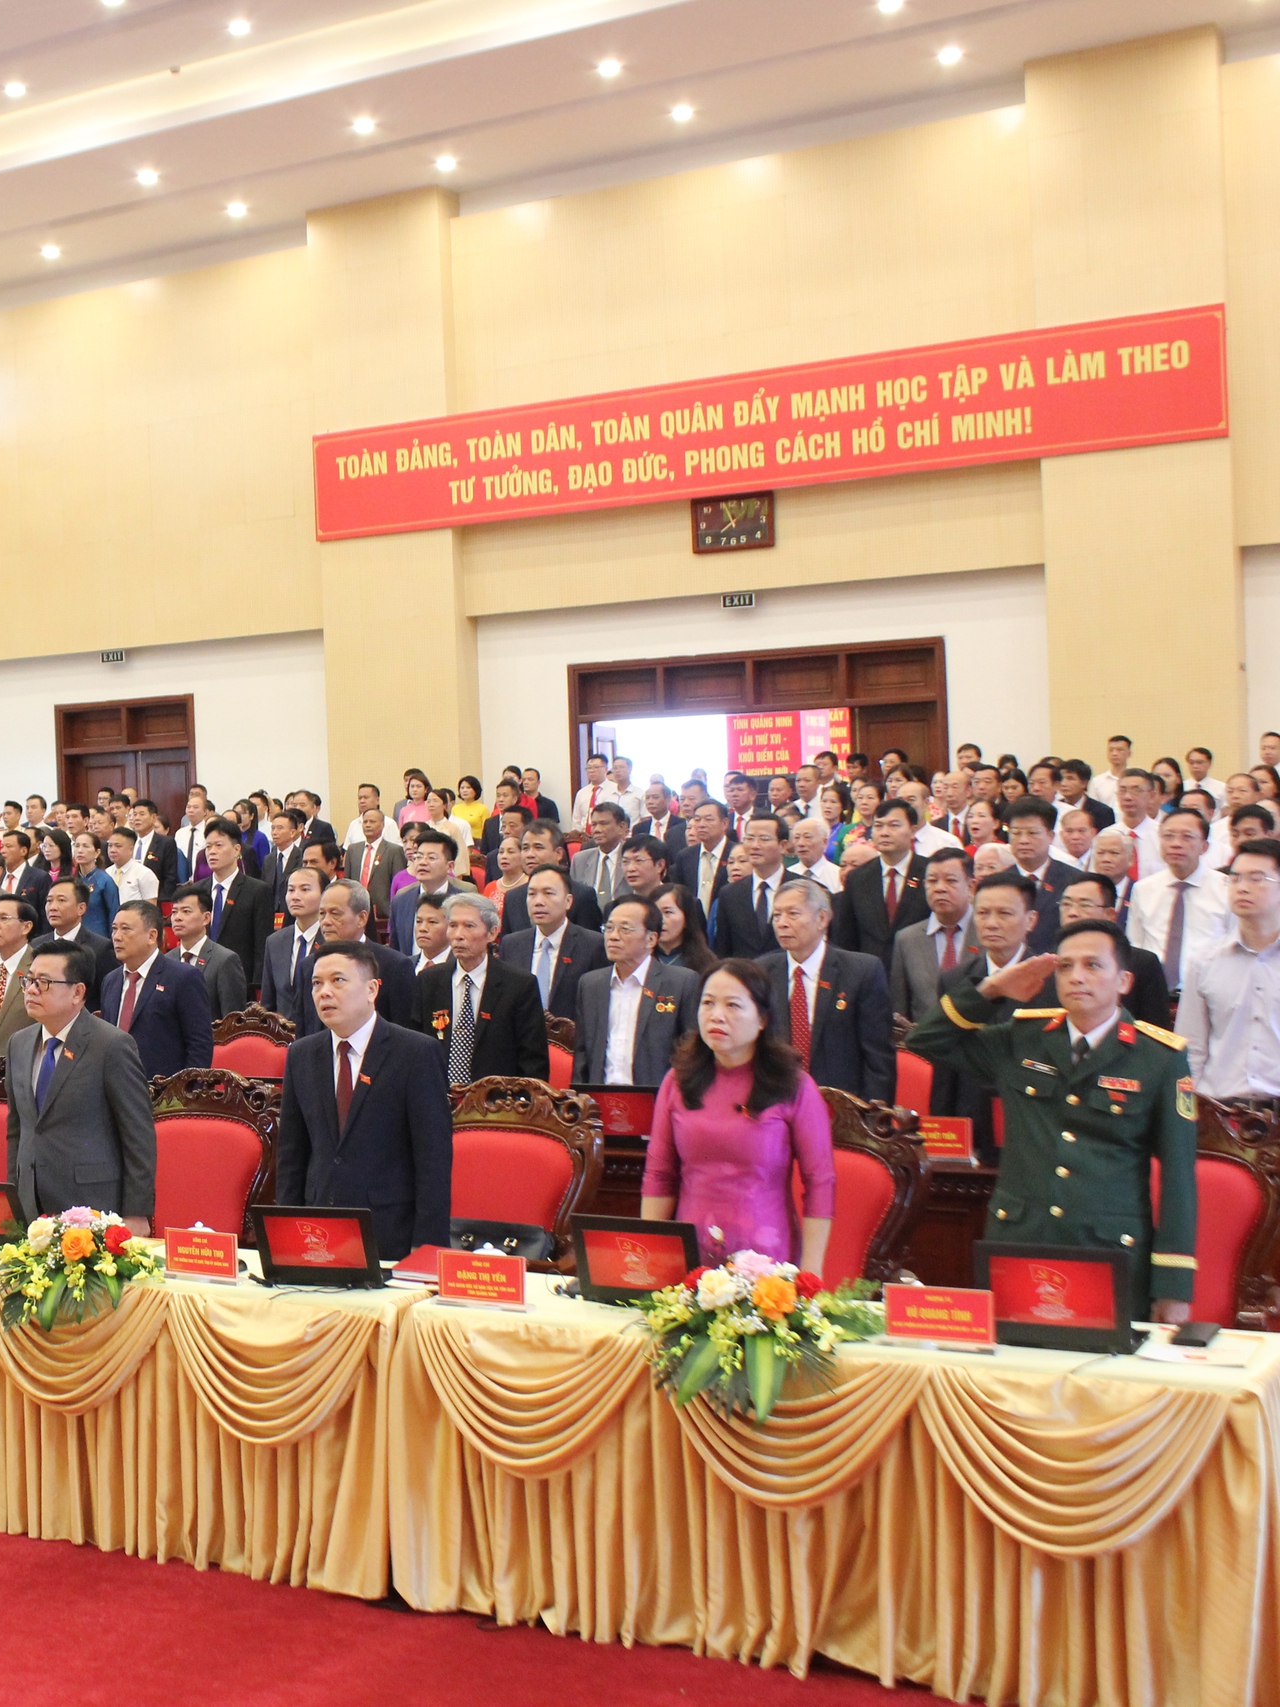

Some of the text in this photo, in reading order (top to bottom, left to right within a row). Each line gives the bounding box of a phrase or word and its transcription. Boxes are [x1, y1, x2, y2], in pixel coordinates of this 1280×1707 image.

[336, 340, 1190, 481] TOÀN ĐẢNG, TOÀN DÂN, TOÀN QUÂN ĐẨY MẠNH HỌC TẬP VÀ LÀM THEO
[449, 407, 1032, 505] TƯ TƯỞNG, ĐẠO ĐỨC, PHONG CÁCH HỒ CHÍ MINH!
[703, 506, 712, 514] 10
[706, 536, 712, 544] 8
[755, 531, 761, 539] 4
[721, 538, 726, 546] 7
[725, 594, 752, 607] EXIT
[103, 652, 122, 662] EXIT
[751, 715, 773, 730] QUẢNG
[775, 716, 792, 727] NINH
[770, 734, 781, 744] XVI
[178, 1245, 199, 1255] NGUYỄN
[213, 1250, 224, 1259] THỌ
[478, 1273, 490, 1283] THỊ
[492, 1272, 506, 1282] YẾN
